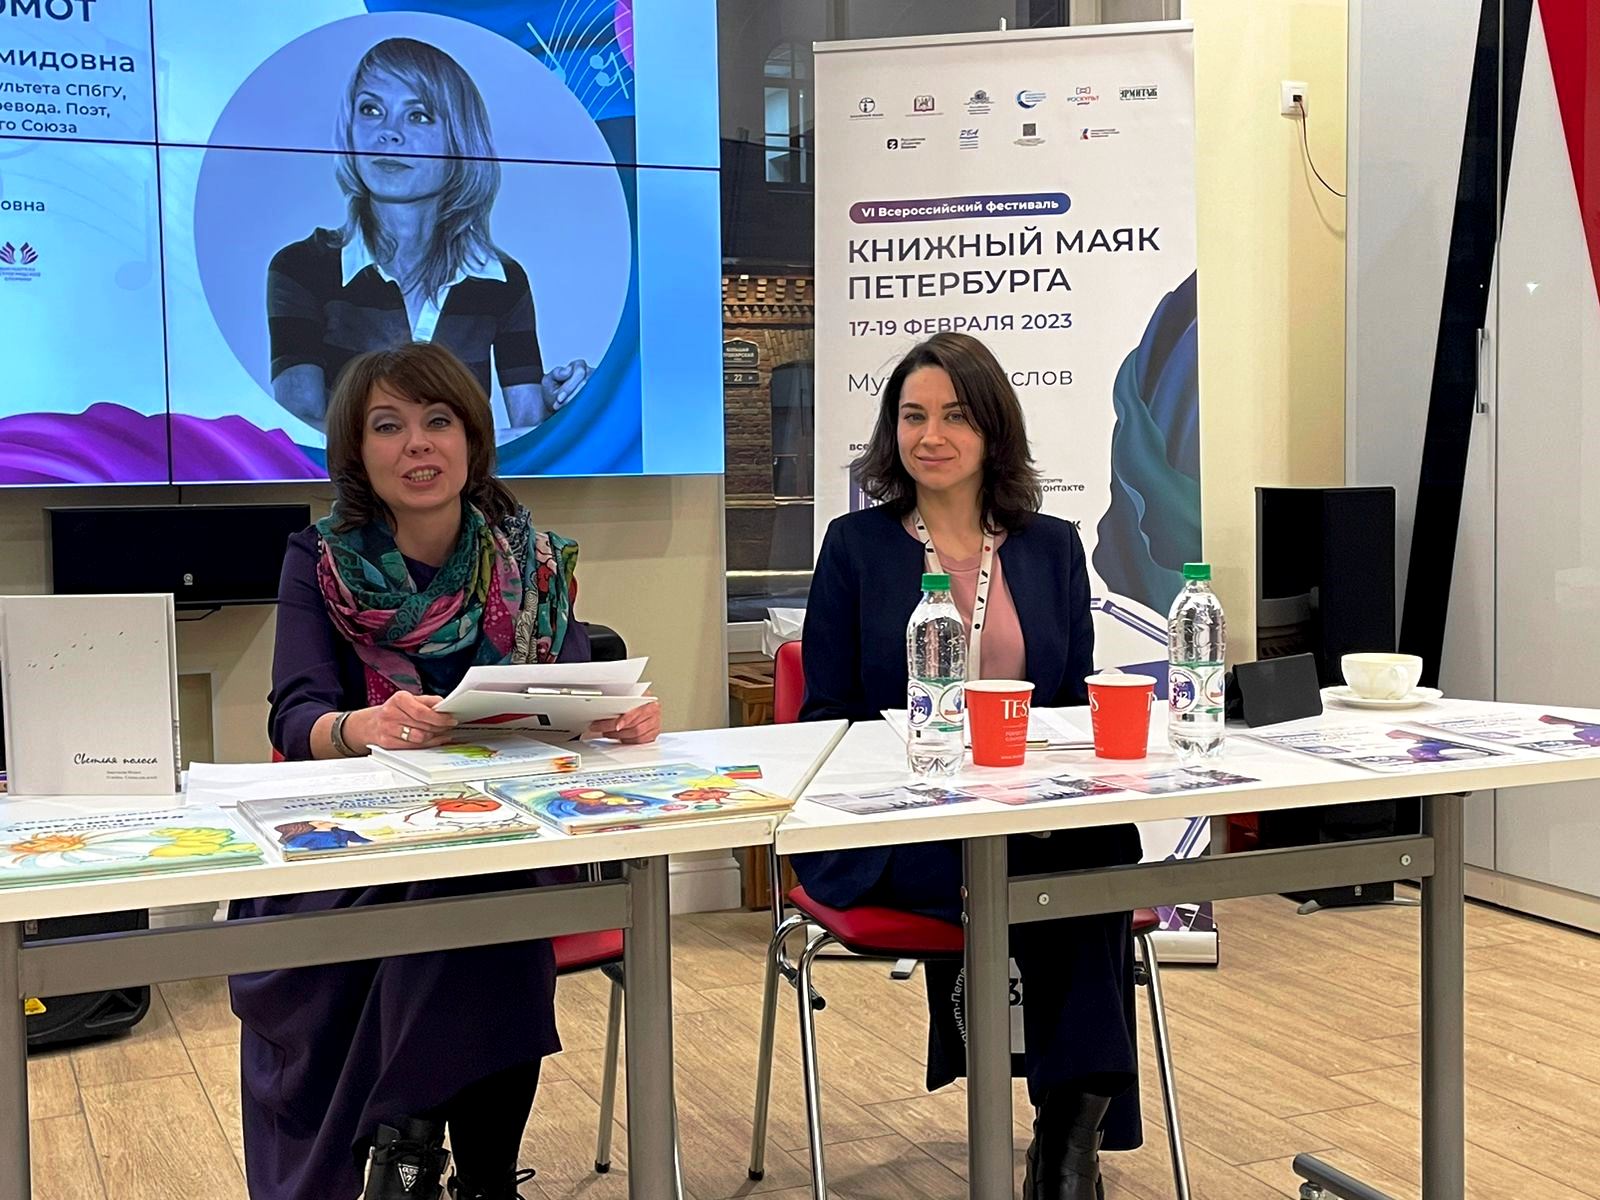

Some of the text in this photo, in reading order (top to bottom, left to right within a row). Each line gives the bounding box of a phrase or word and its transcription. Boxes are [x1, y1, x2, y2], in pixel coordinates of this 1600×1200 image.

[0, 0, 97, 22] МОТ
[0, 49, 135, 73] мидовна
[65, 83, 126, 101] СПбГУ,
[0, 101, 110, 119] евода. Поэт,
[21, 119, 77, 134] Союза
[0, 200, 46, 211] овна
[861, 199, 1060, 218] VI Всероссийский фестиваль
[848, 226, 1161, 263] КНИЖНЫЙ МАЯК
[849, 268, 1072, 300] ПЕТЕРБУРГА
[849, 313, 1073, 337] 17-19 ФЕВРАЛЯ 2023
[1005, 370, 1073, 387] слов
[1041, 484, 1085, 492] онтакте
